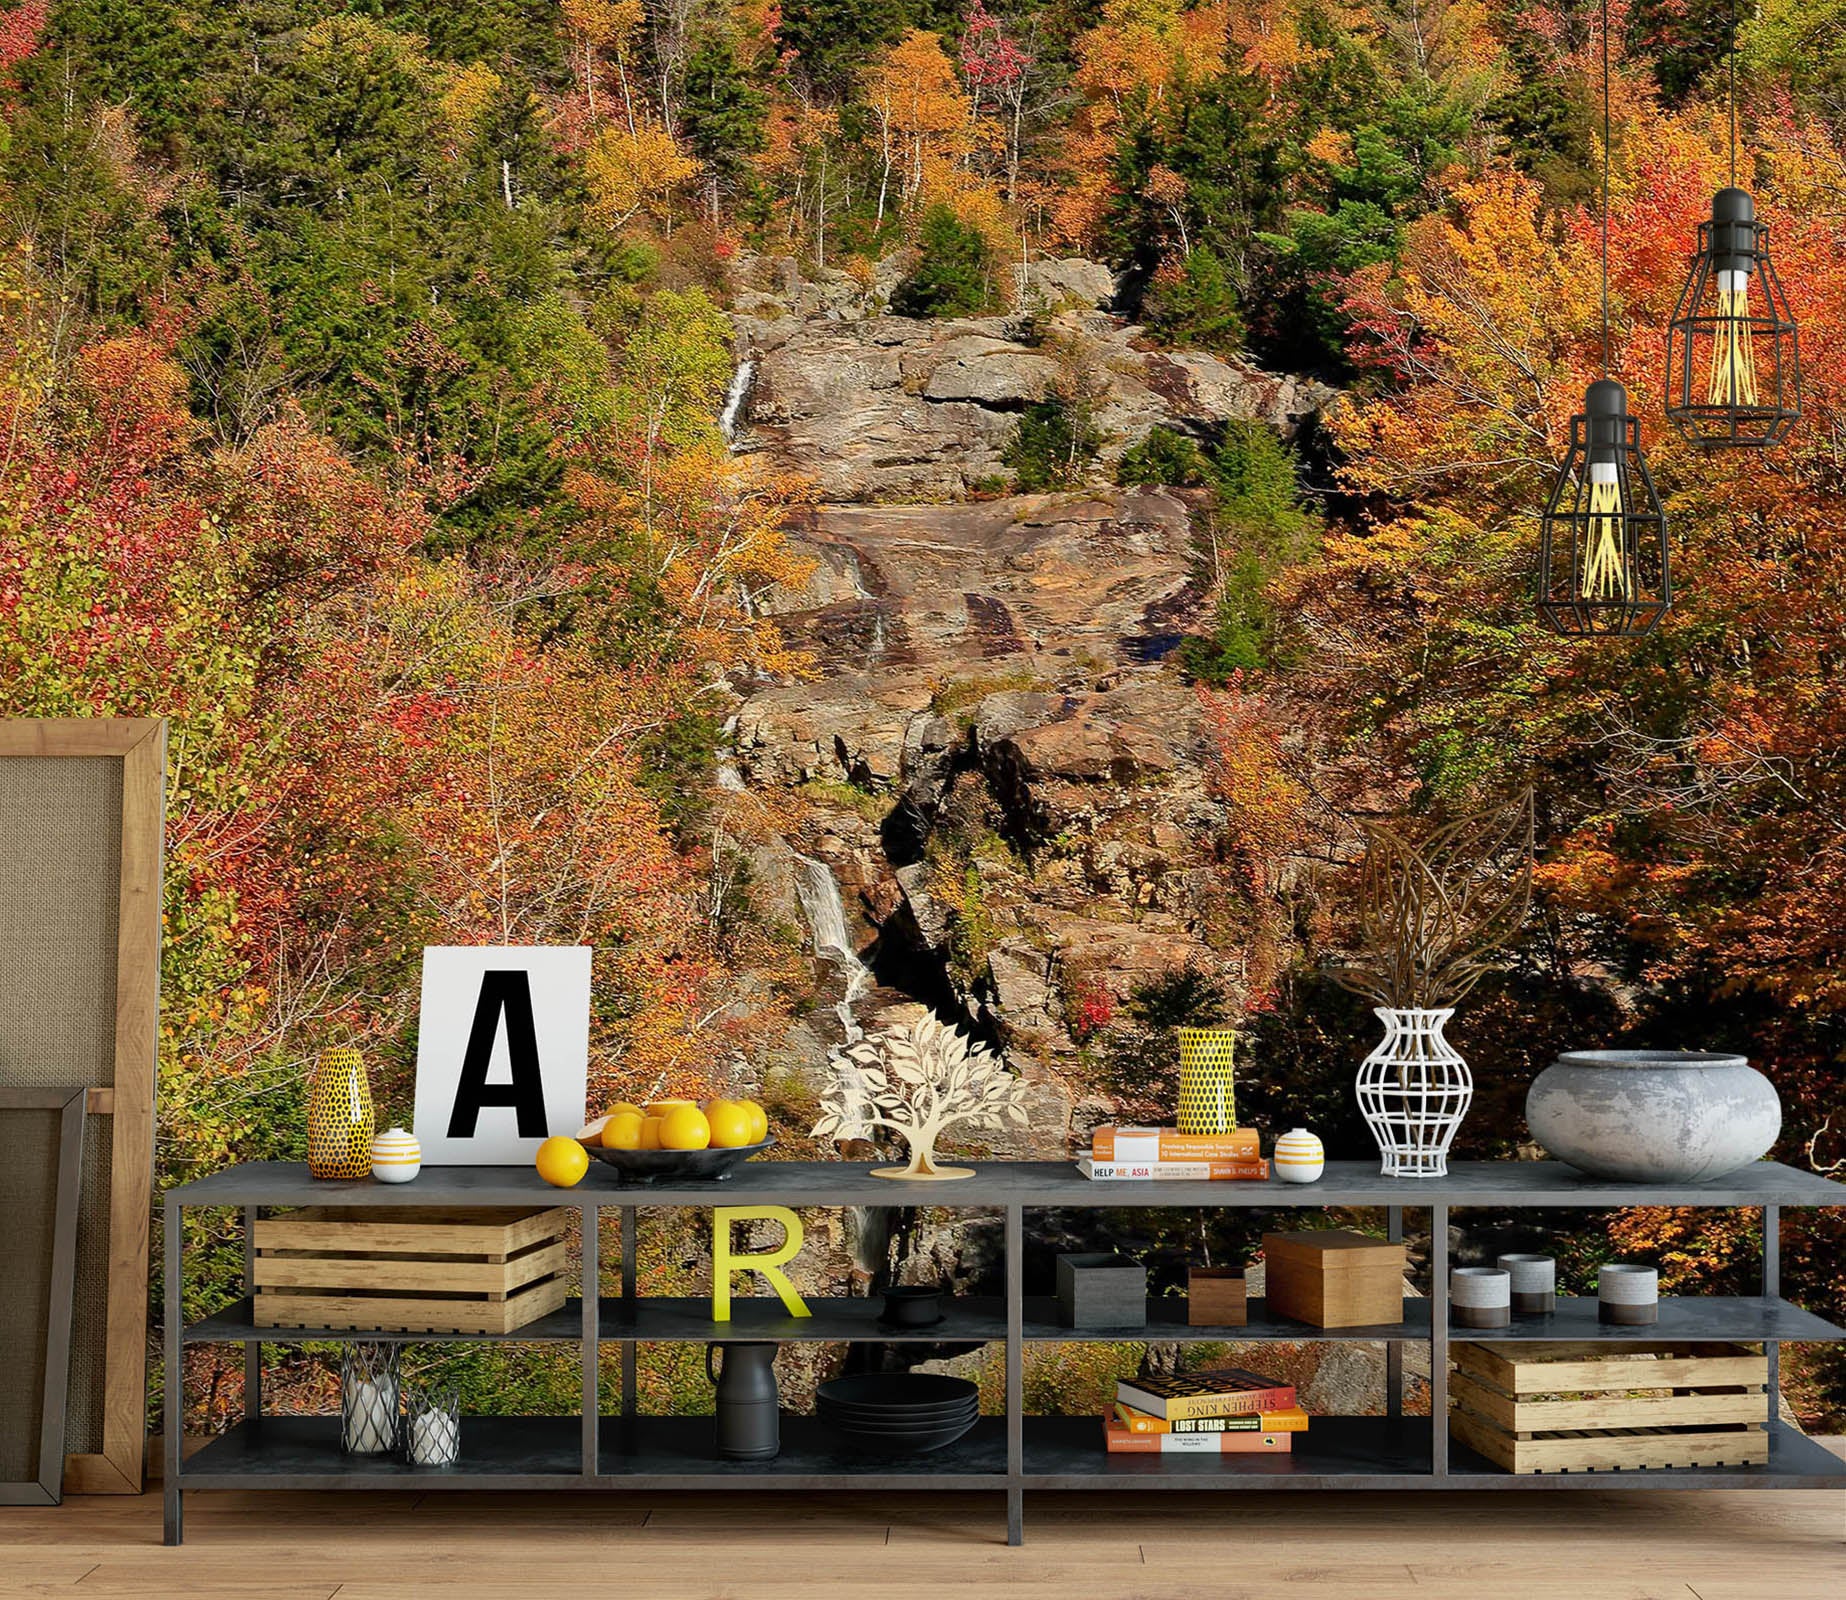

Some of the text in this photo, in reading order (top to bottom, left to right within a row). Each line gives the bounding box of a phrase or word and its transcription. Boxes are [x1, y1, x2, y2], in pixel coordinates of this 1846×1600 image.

[447, 970, 549, 1138] A
[1094, 1168, 1114, 1177] HELP
[1131, 1168, 1149, 1177] ASIA
[711, 1205, 812, 1322] R
[1187, 1398, 1276, 1417] STEPHEN KING
[1175, 1420, 1196, 1432] LOST
[1197, 1419, 1226, 1432] STARS
